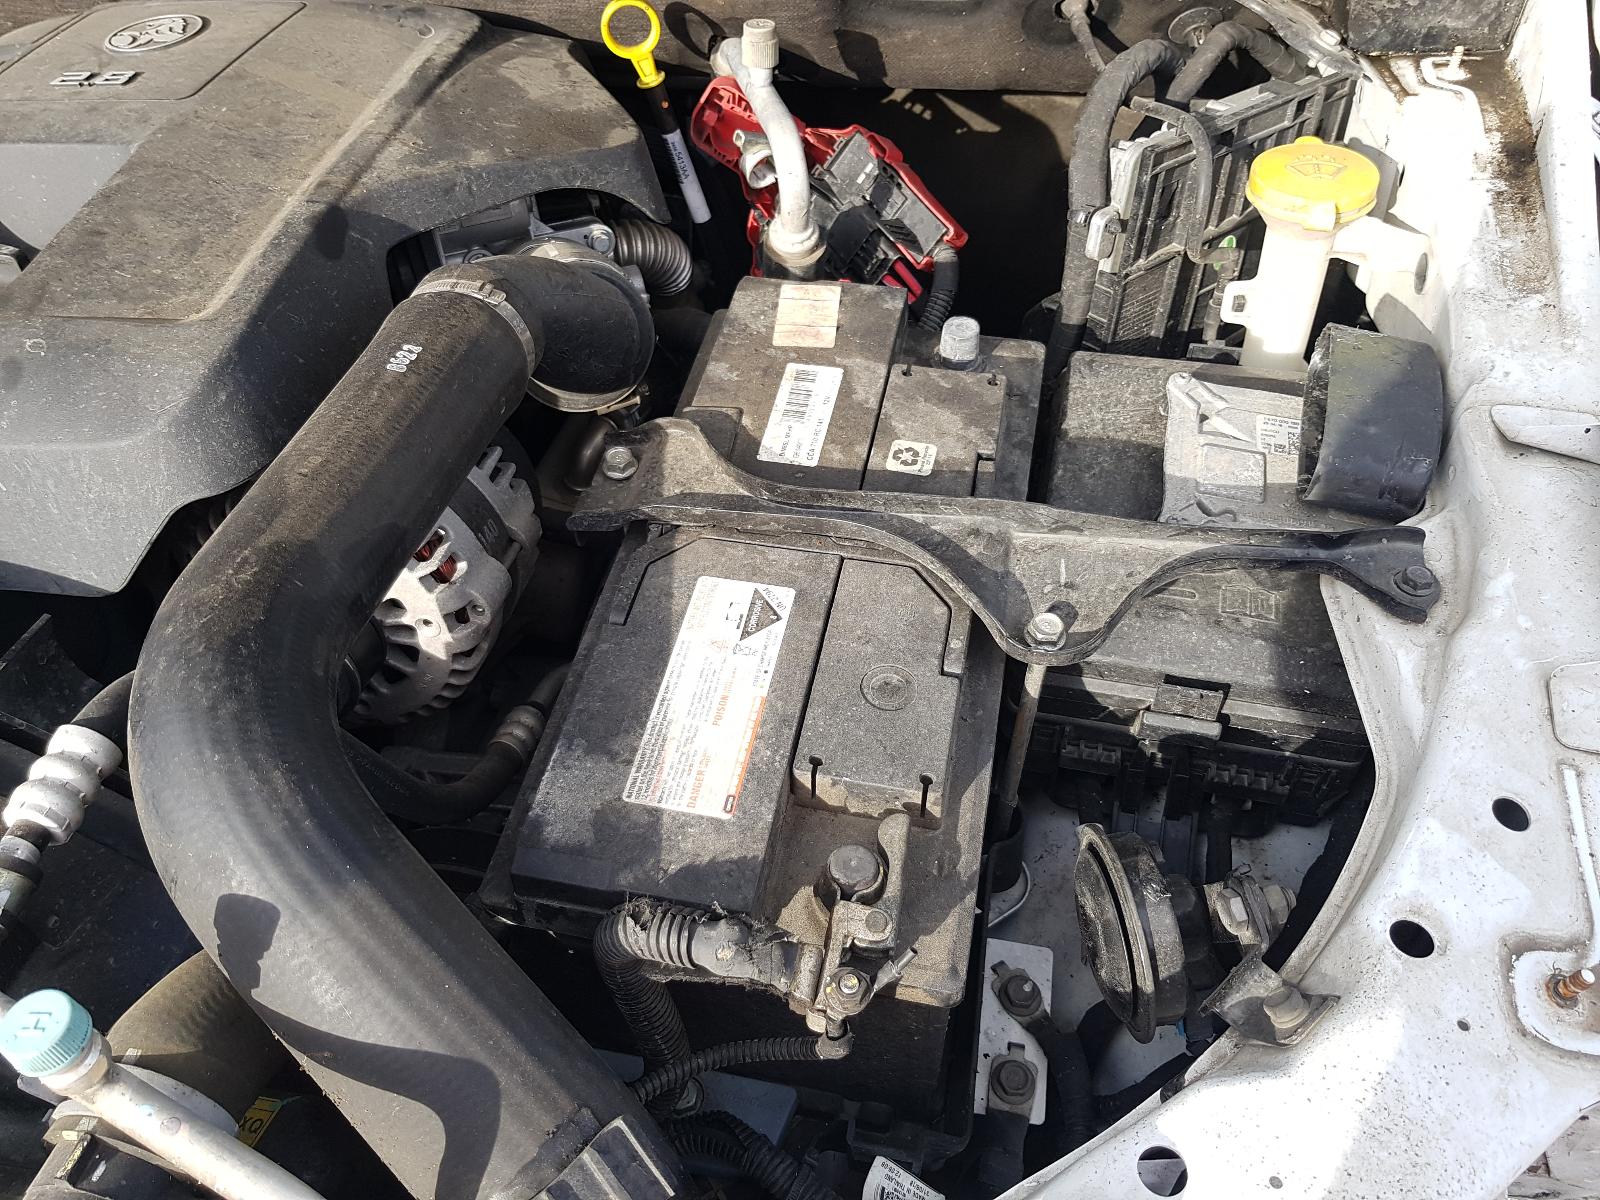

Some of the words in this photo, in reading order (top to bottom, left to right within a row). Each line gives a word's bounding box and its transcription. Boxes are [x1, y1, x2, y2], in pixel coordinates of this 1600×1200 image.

[49, 71, 137, 86] 2.8
[747, 598, 764, 632] CORROSIVE
[711, 693, 730, 727] POISON
[686, 768, 707, 809] DANGER
